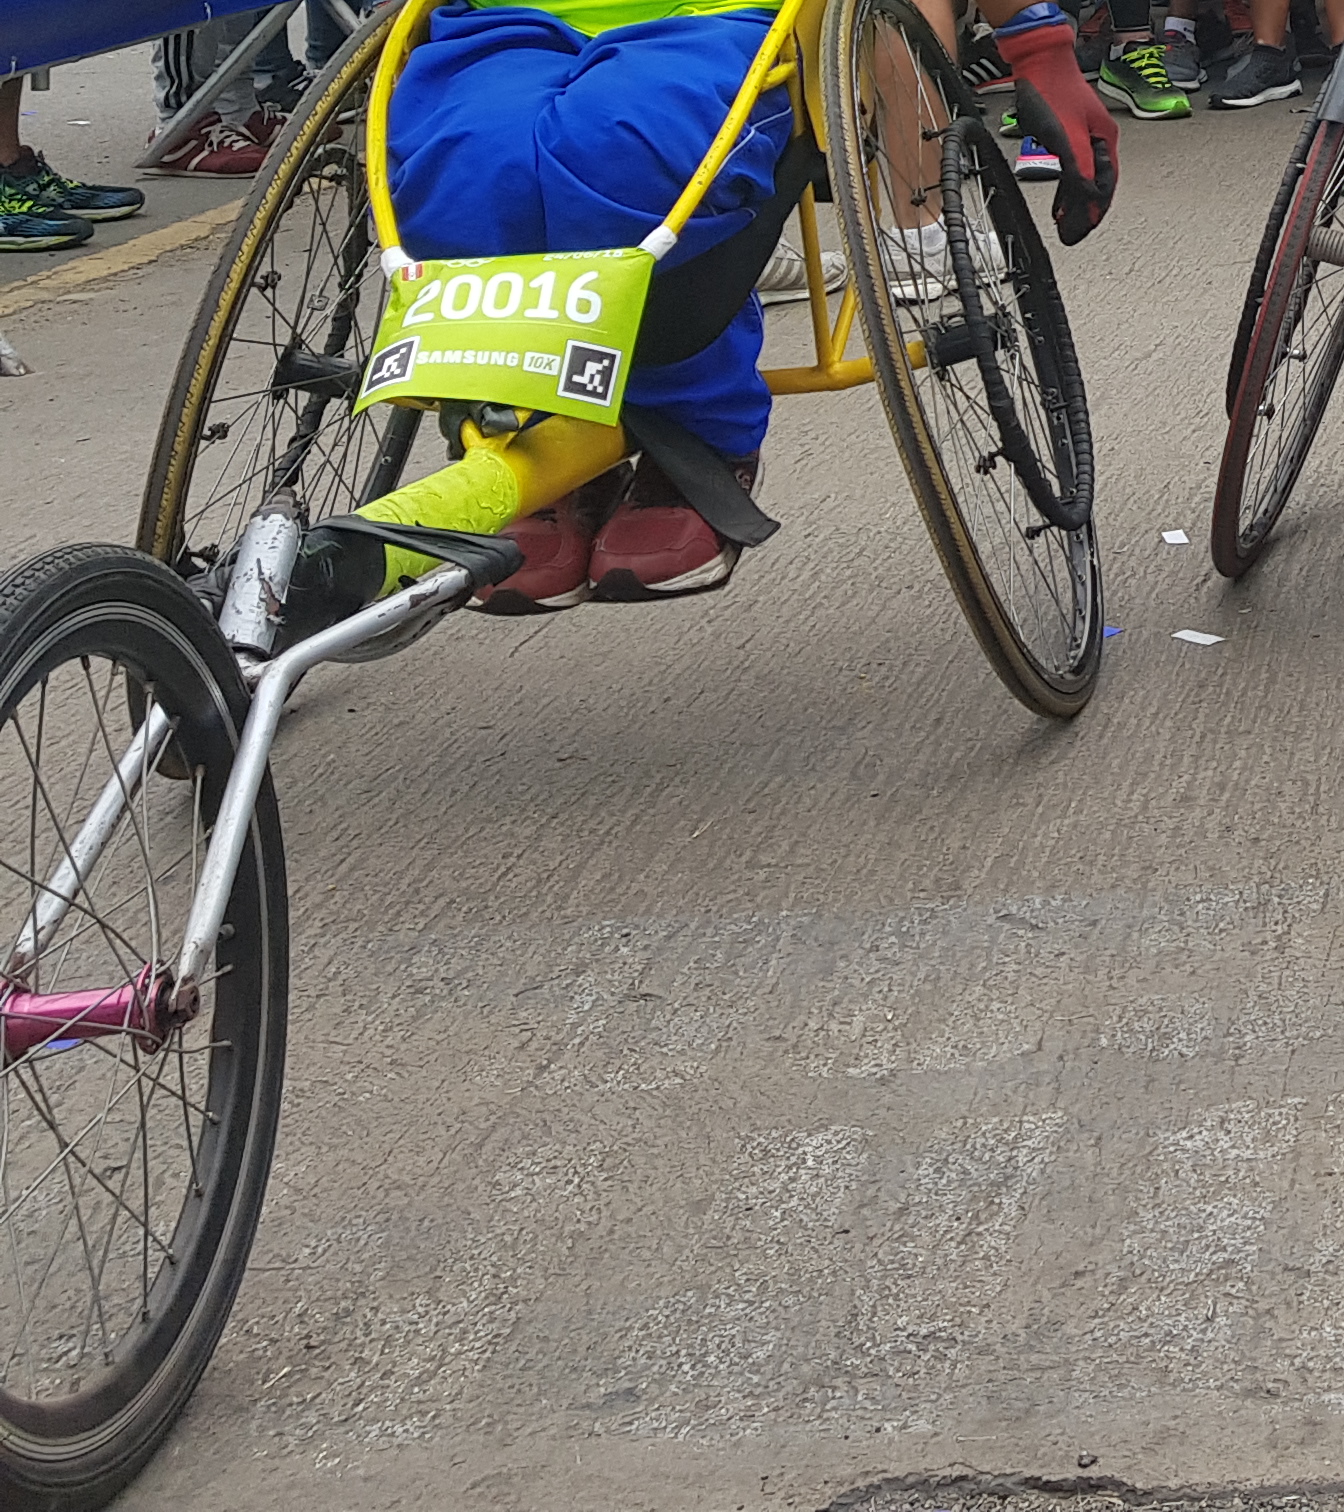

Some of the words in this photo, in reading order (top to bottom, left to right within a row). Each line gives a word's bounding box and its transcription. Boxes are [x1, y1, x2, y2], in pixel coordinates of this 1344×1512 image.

[402, 271, 603, 328] 20016
[416, 349, 519, 367] SAMSUNG
[526, 354, 556, 372] 10K
